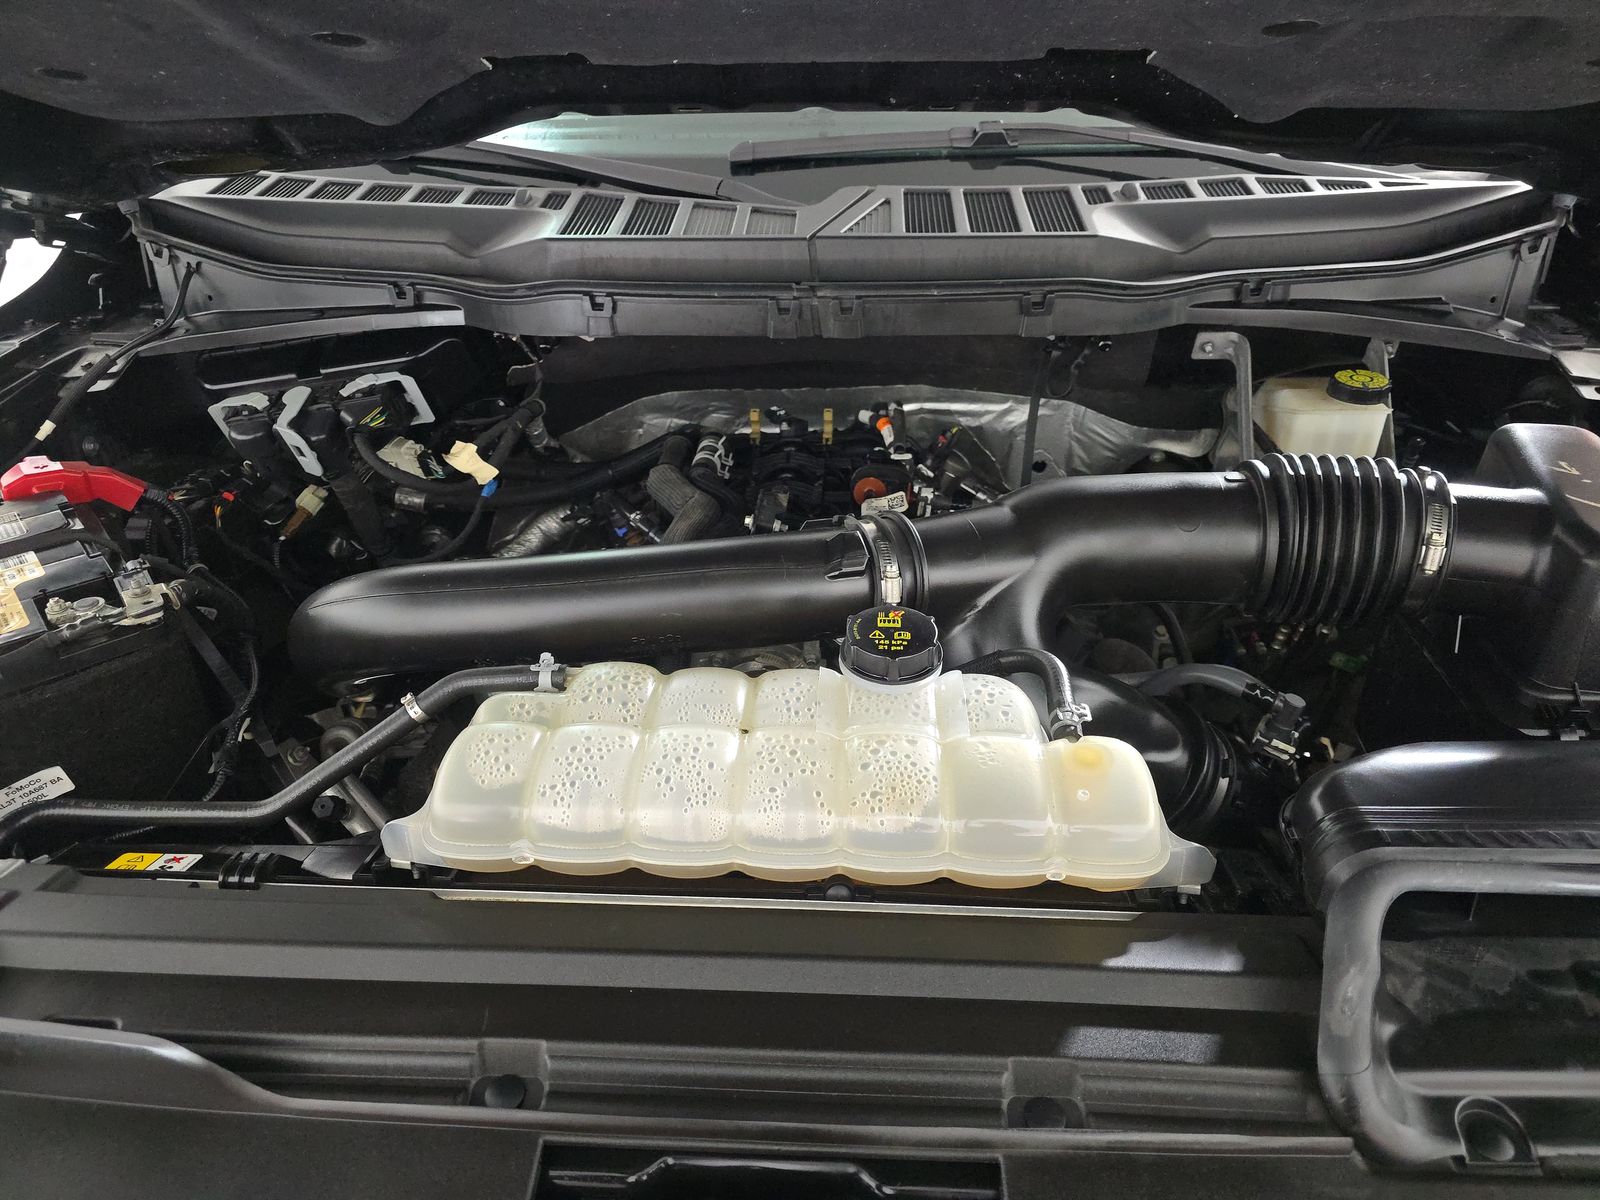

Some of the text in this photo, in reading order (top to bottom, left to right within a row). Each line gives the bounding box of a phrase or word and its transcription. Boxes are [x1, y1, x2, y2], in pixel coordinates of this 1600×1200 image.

[0, 776, 64, 810] L3T 10A687 BA
[5, 778, 42, 797] FoMoCo
